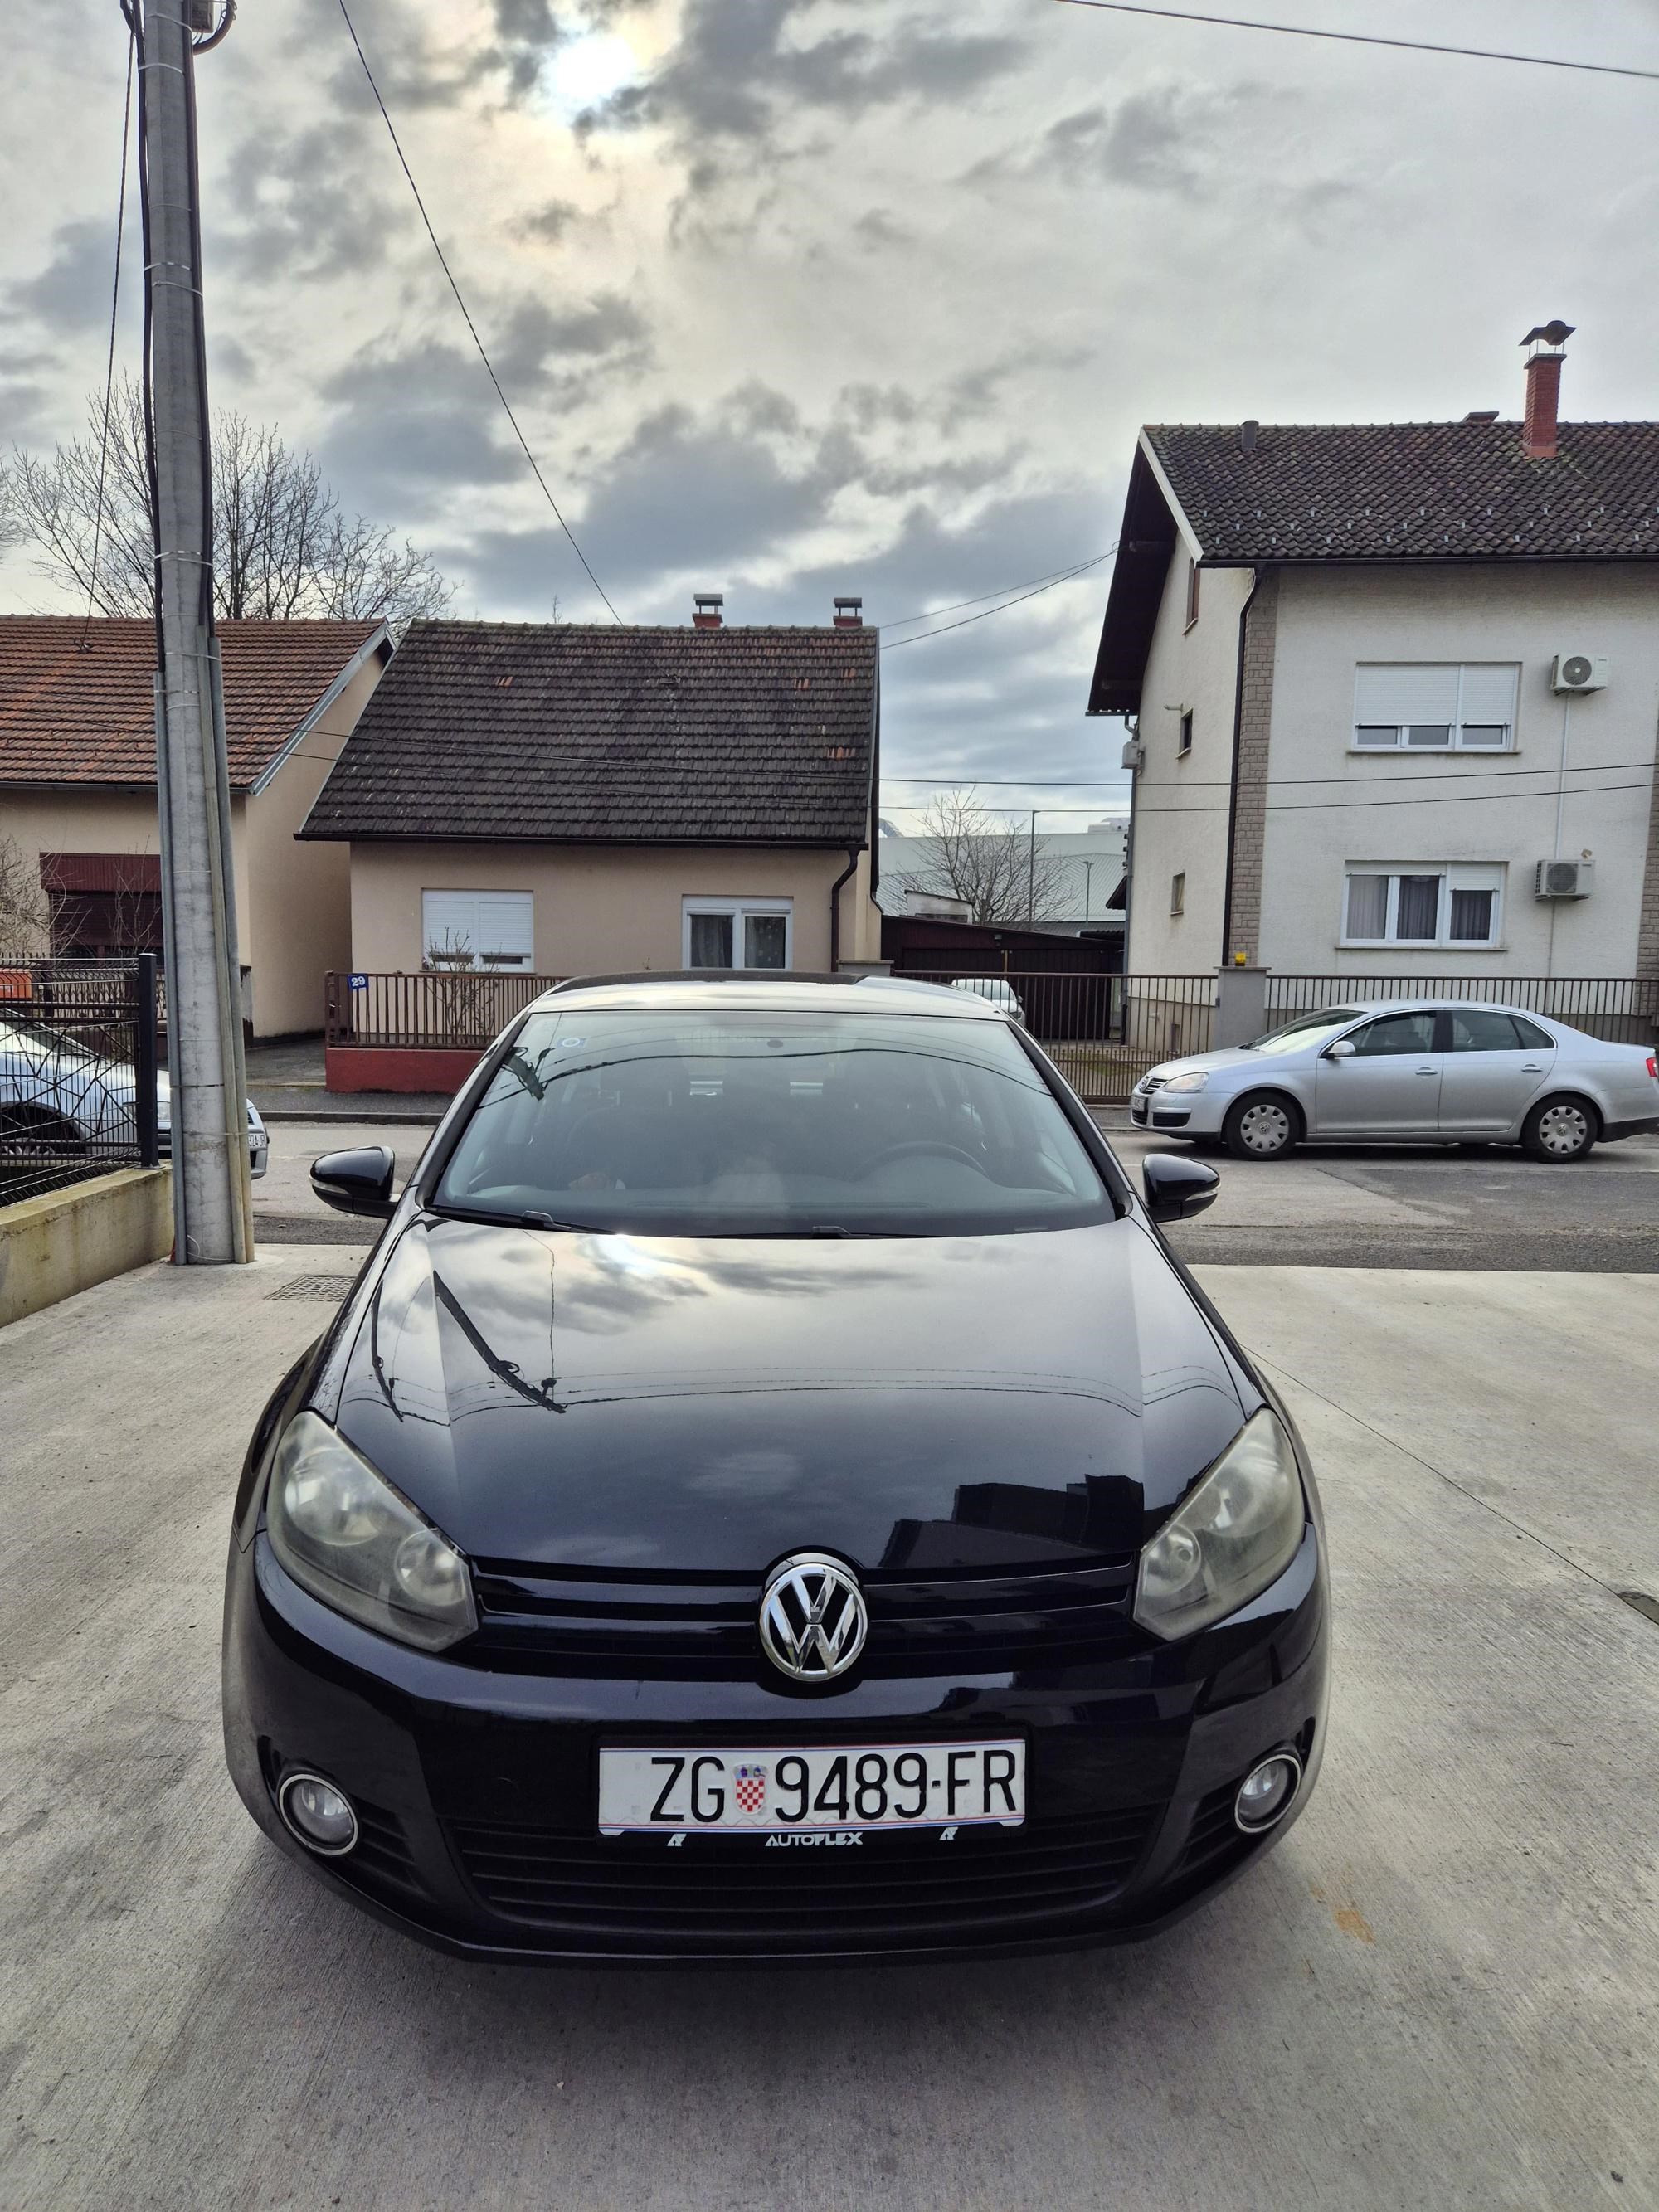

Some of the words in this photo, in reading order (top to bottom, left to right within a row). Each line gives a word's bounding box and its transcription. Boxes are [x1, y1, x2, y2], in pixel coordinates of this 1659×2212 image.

[351, 976, 366, 987] 29
[649, 1757, 726, 1822] ZG
[775, 1750, 1017, 1822] 9489-FR
[765, 1831, 863, 1846] AUTOFLEX
